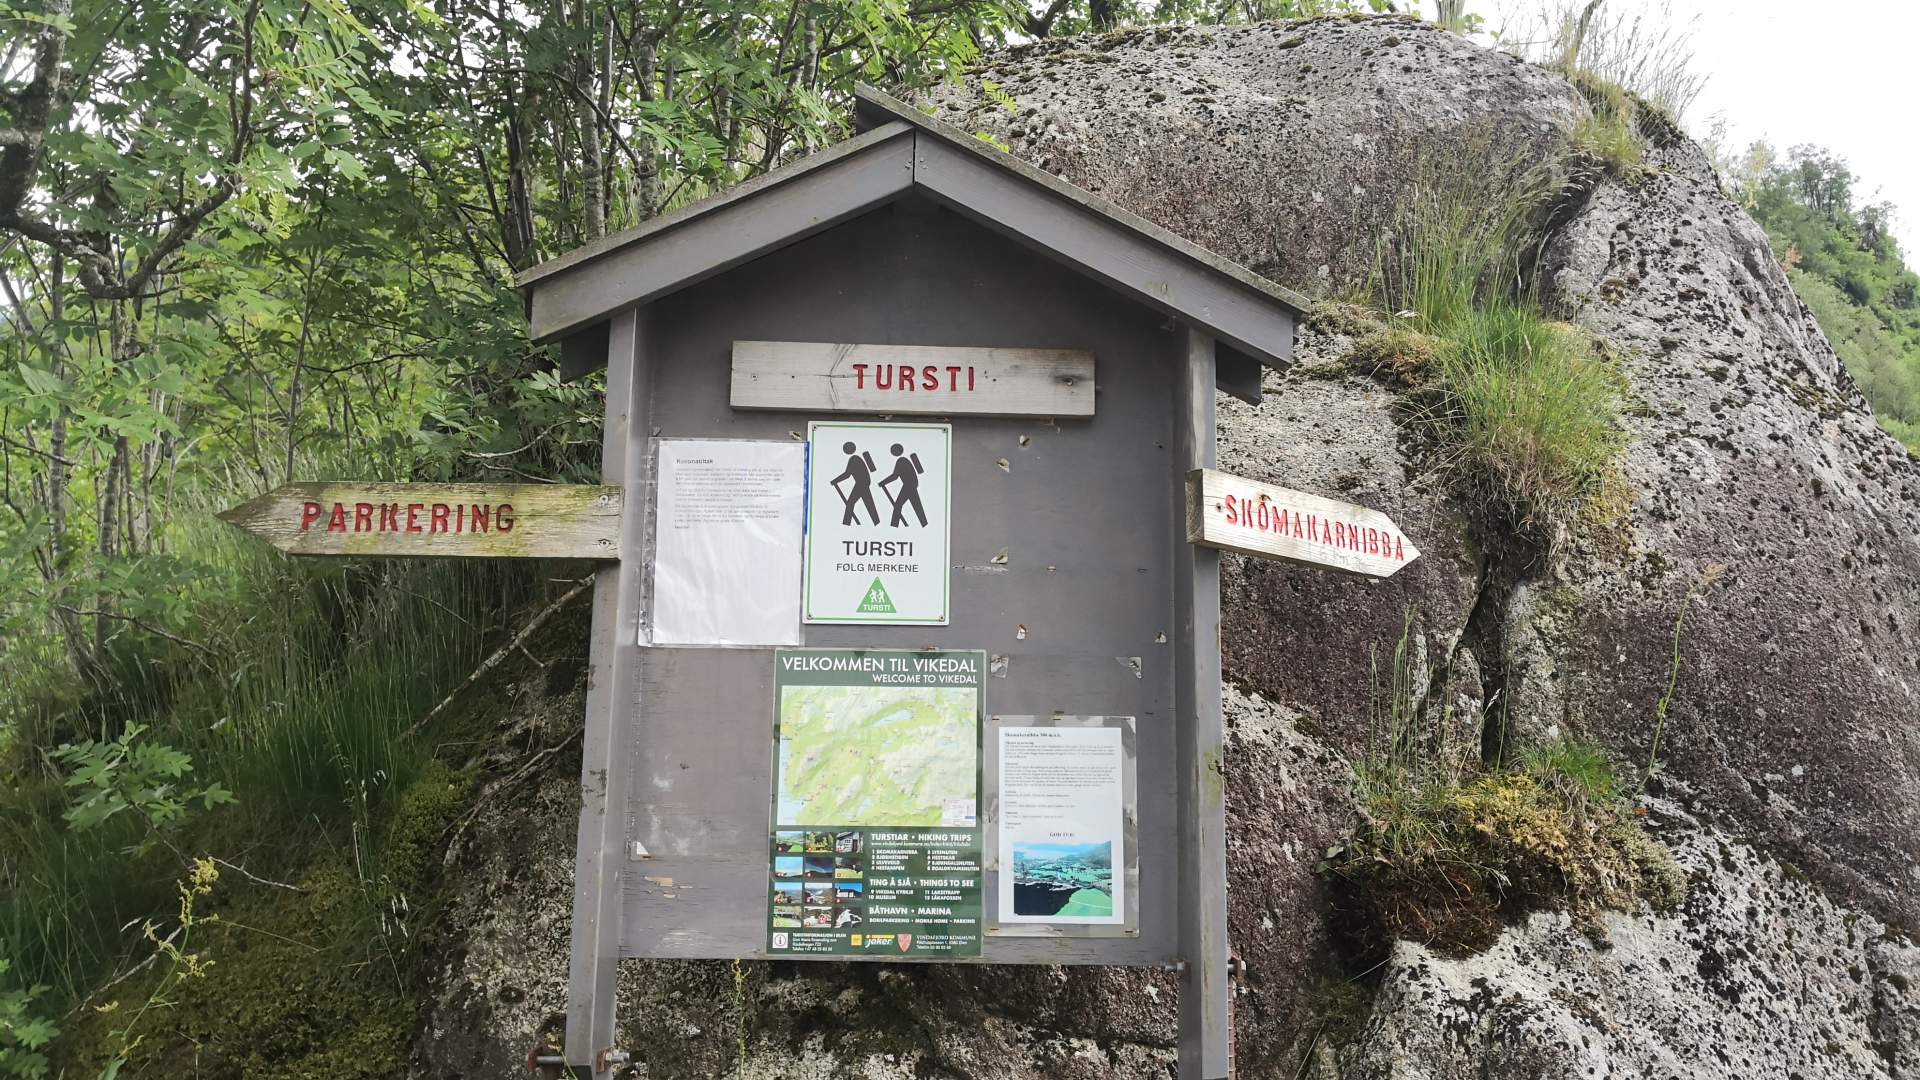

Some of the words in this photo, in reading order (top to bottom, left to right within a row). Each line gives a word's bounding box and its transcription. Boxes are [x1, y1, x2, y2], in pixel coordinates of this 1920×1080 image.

[853, 364, 975, 392] TURSTI
[301, 502, 514, 534] PARKERING
[842, 540, 913, 557] TURSTI
[836, 563, 865, 572] FØLG
[867, 563, 919, 573] MERKENE
[863, 604, 891, 612] TURSTI
[782, 657, 884, 672] VELKOMMEN
[889, 658, 909, 672] TIL
[912, 659, 978, 673] VIKEDAL
[872, 674, 921, 683] WELCOME
[923, 675, 936, 683] TO
[938, 675, 978, 684] VIKEDAL
[871, 833, 908, 841] TURSTIAR
[950, 834, 972, 842] TRIPS
[890, 877, 896, 886] Å
[898, 877, 911, 886] SJÅ
[920, 879, 948, 887] THINGS
[950, 879, 960, 887] TO
[869, 905, 908, 915] BÅTHAVN
[918, 907, 952, 915] MARINA
[865, 934, 893, 948] joker
